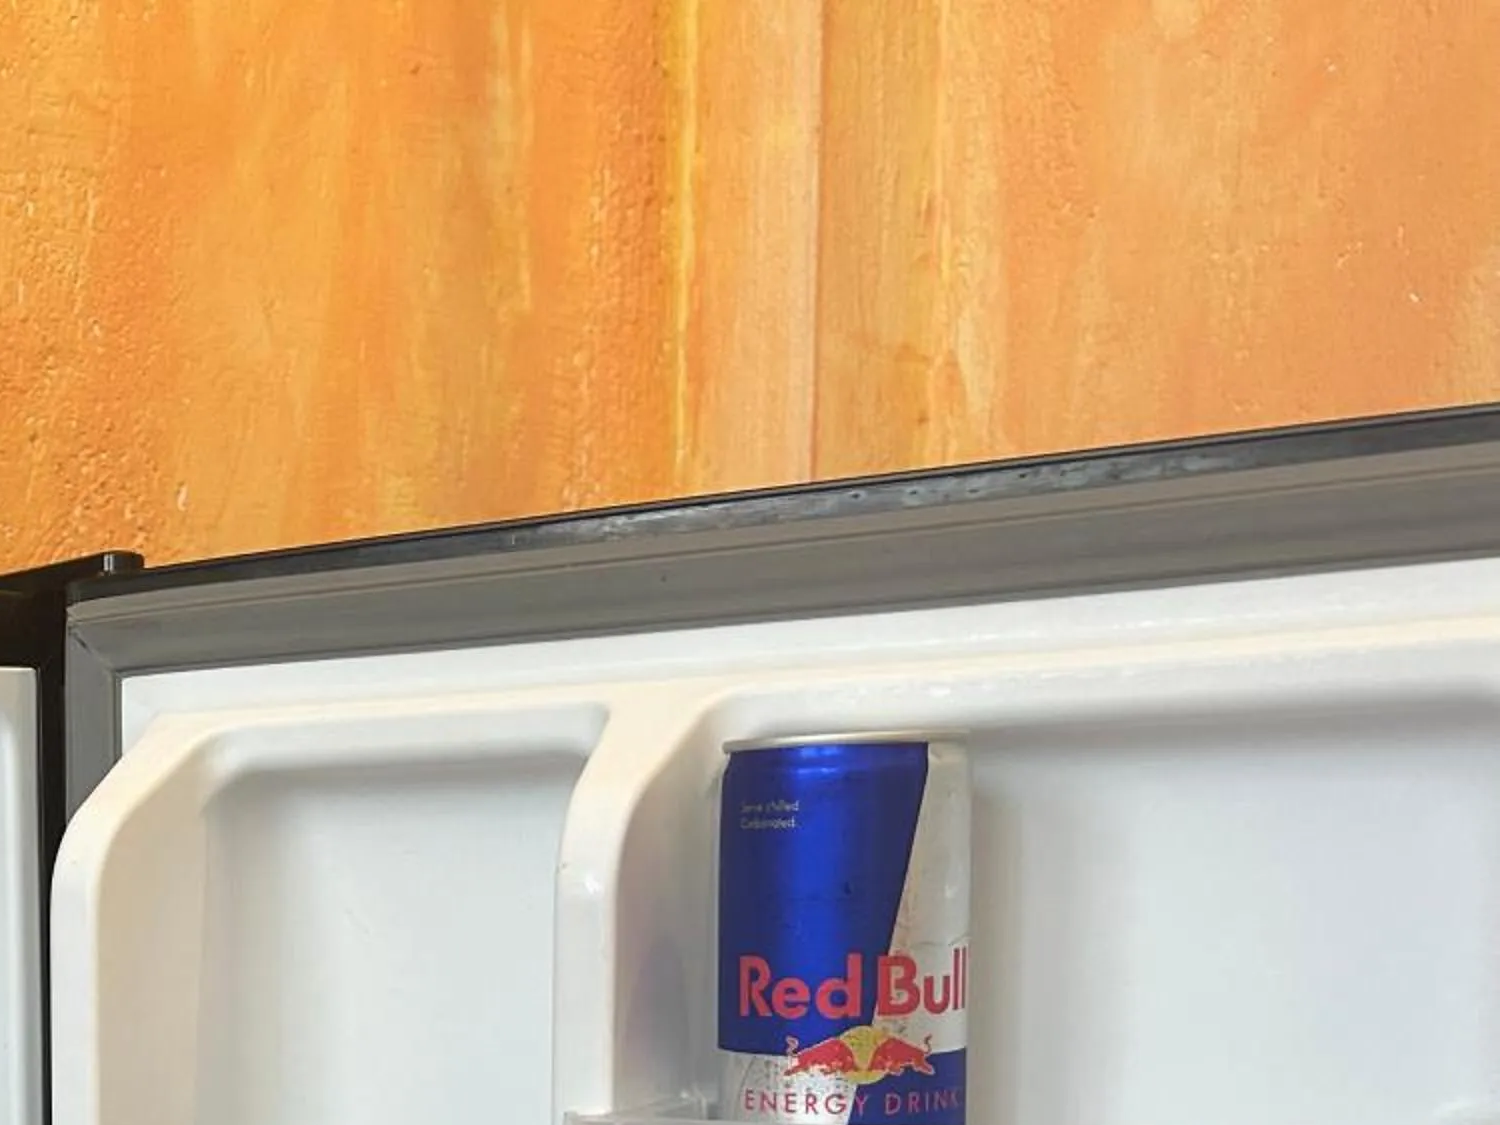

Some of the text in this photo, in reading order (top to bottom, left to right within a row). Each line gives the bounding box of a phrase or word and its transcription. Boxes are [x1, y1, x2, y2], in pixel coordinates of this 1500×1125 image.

[738, 946, 968, 1021] Red Bull
[744, 1087, 964, 1118] ENERGY DRINK
